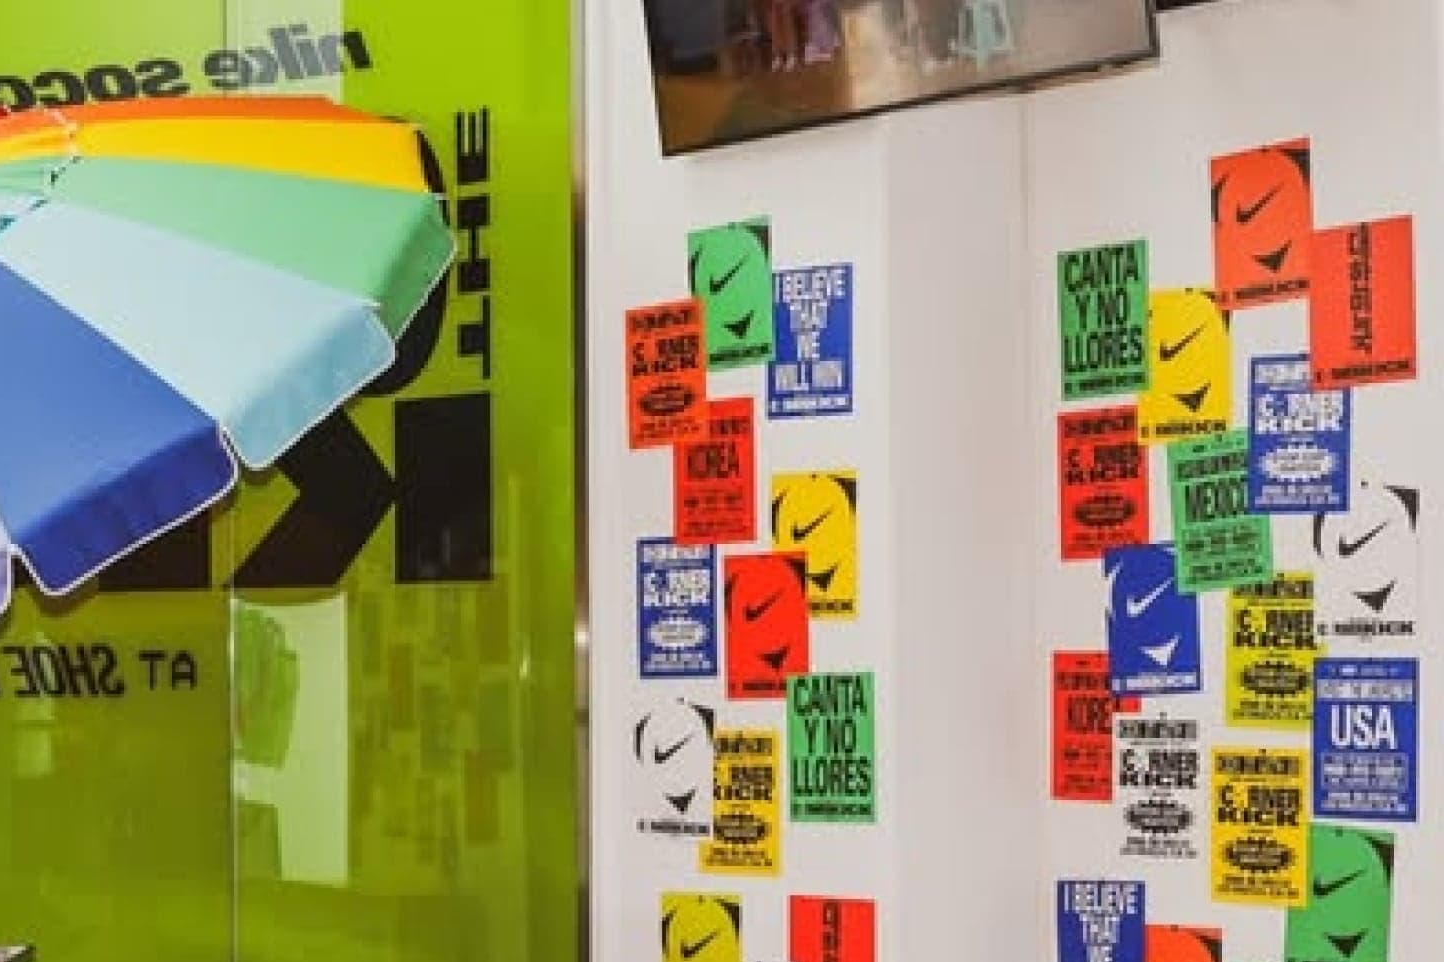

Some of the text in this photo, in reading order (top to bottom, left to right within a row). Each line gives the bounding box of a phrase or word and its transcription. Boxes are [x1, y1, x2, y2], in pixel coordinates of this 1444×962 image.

[1064, 242, 1140, 293] CANTA
[782, 269, 846, 303] BELIEVE
[790, 298, 828, 331] THAT
[1077, 287, 1129, 329] Y NO
[633, 335, 700, 363] CRNER
[798, 331, 820, 361] WE
[1064, 329, 1144, 373] LLORES
[1255, 392, 1345, 418] CRNER
[1067, 446, 1139, 472] CRNER
[643, 569, 710, 595] CRNER
[1234, 608, 1316, 635] CRNER
[793, 676, 866, 716] CANTA
[804, 719, 857, 753] Y NO
[1330, 704, 1398, 751] USA
[1121, 748, 1199, 774] CRNER
[793, 758, 871, 798] LLORES
[1220, 785, 1302, 811] CRNER
[1074, 883, 1138, 915] BELIEVE
[1080, 914, 1121, 944] THAT
